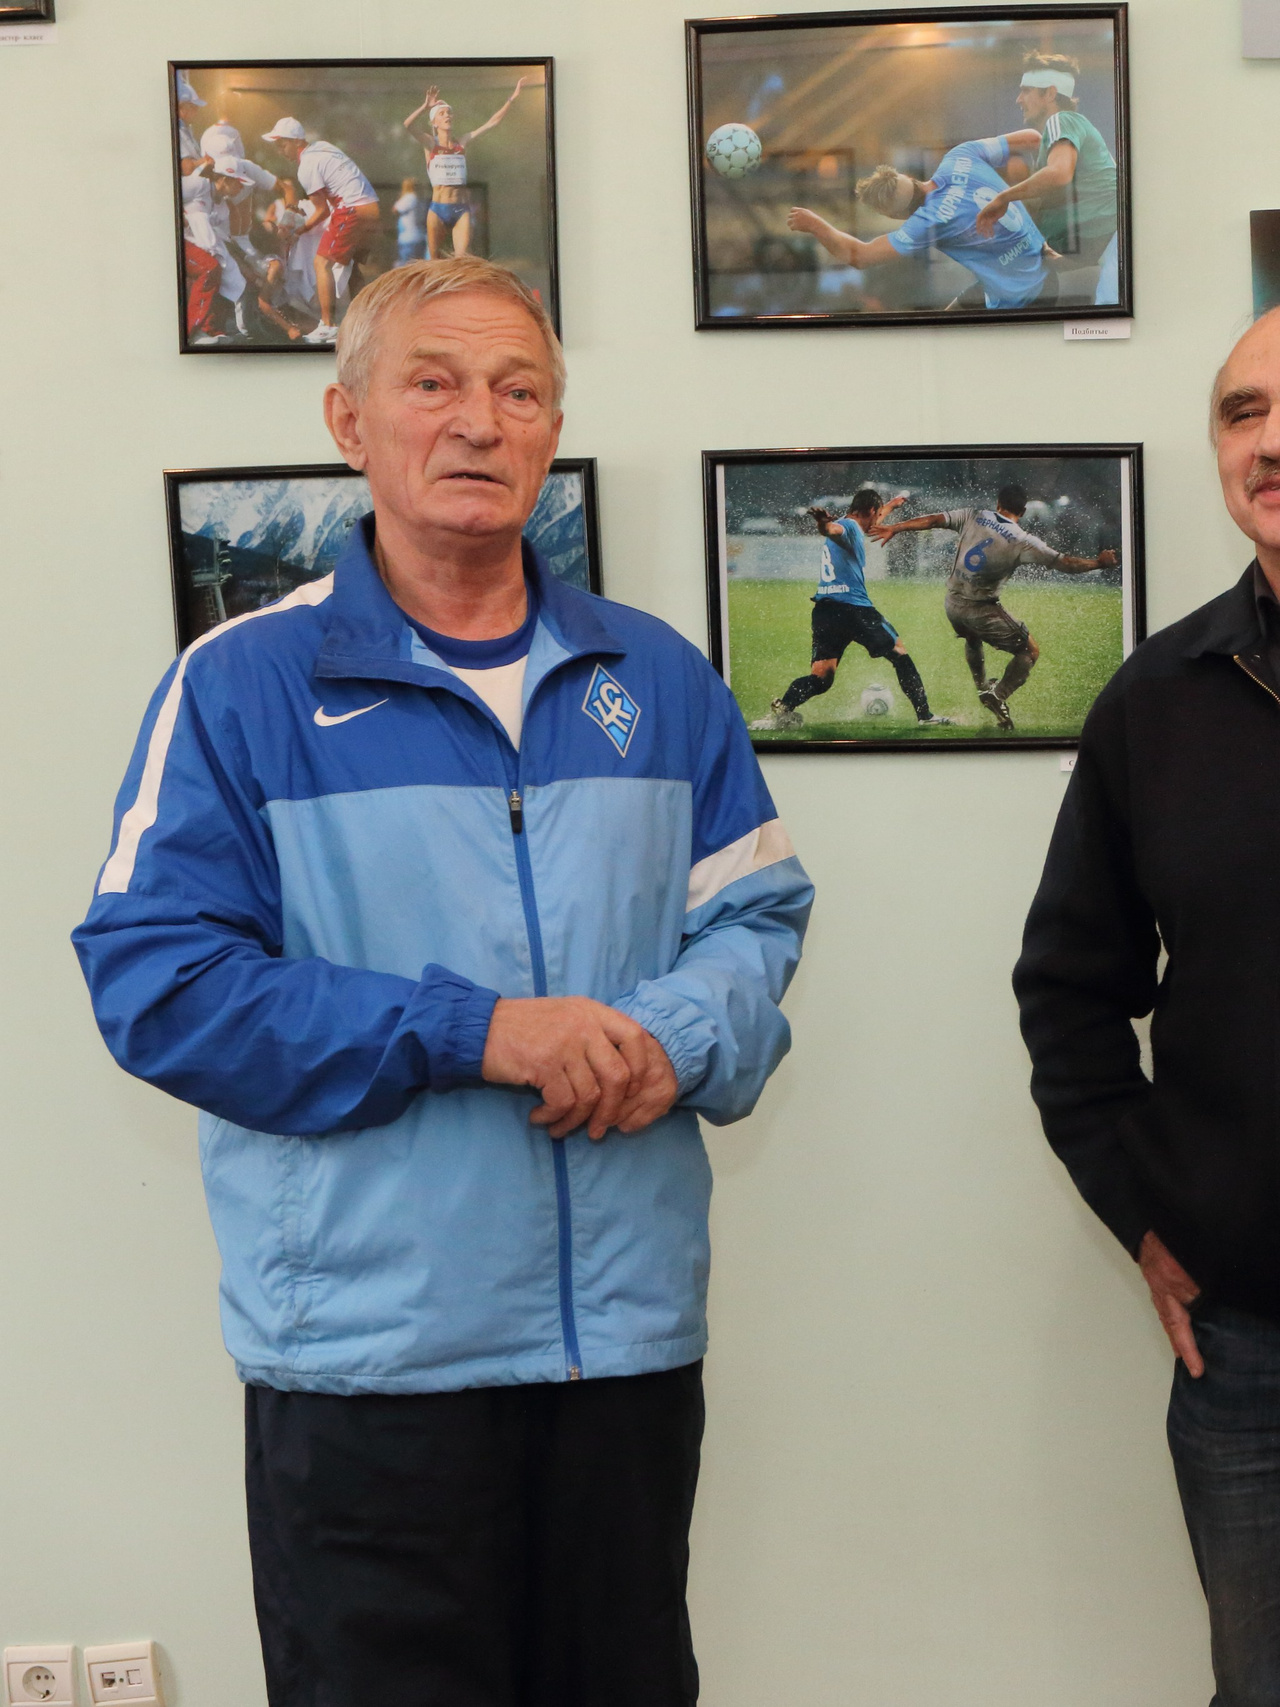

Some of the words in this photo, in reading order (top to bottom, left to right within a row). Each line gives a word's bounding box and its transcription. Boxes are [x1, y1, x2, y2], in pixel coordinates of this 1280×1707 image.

[1071, 327, 1109, 335] Подбитые
[821, 544, 836, 583] 8
[963, 536, 994, 573] 6
